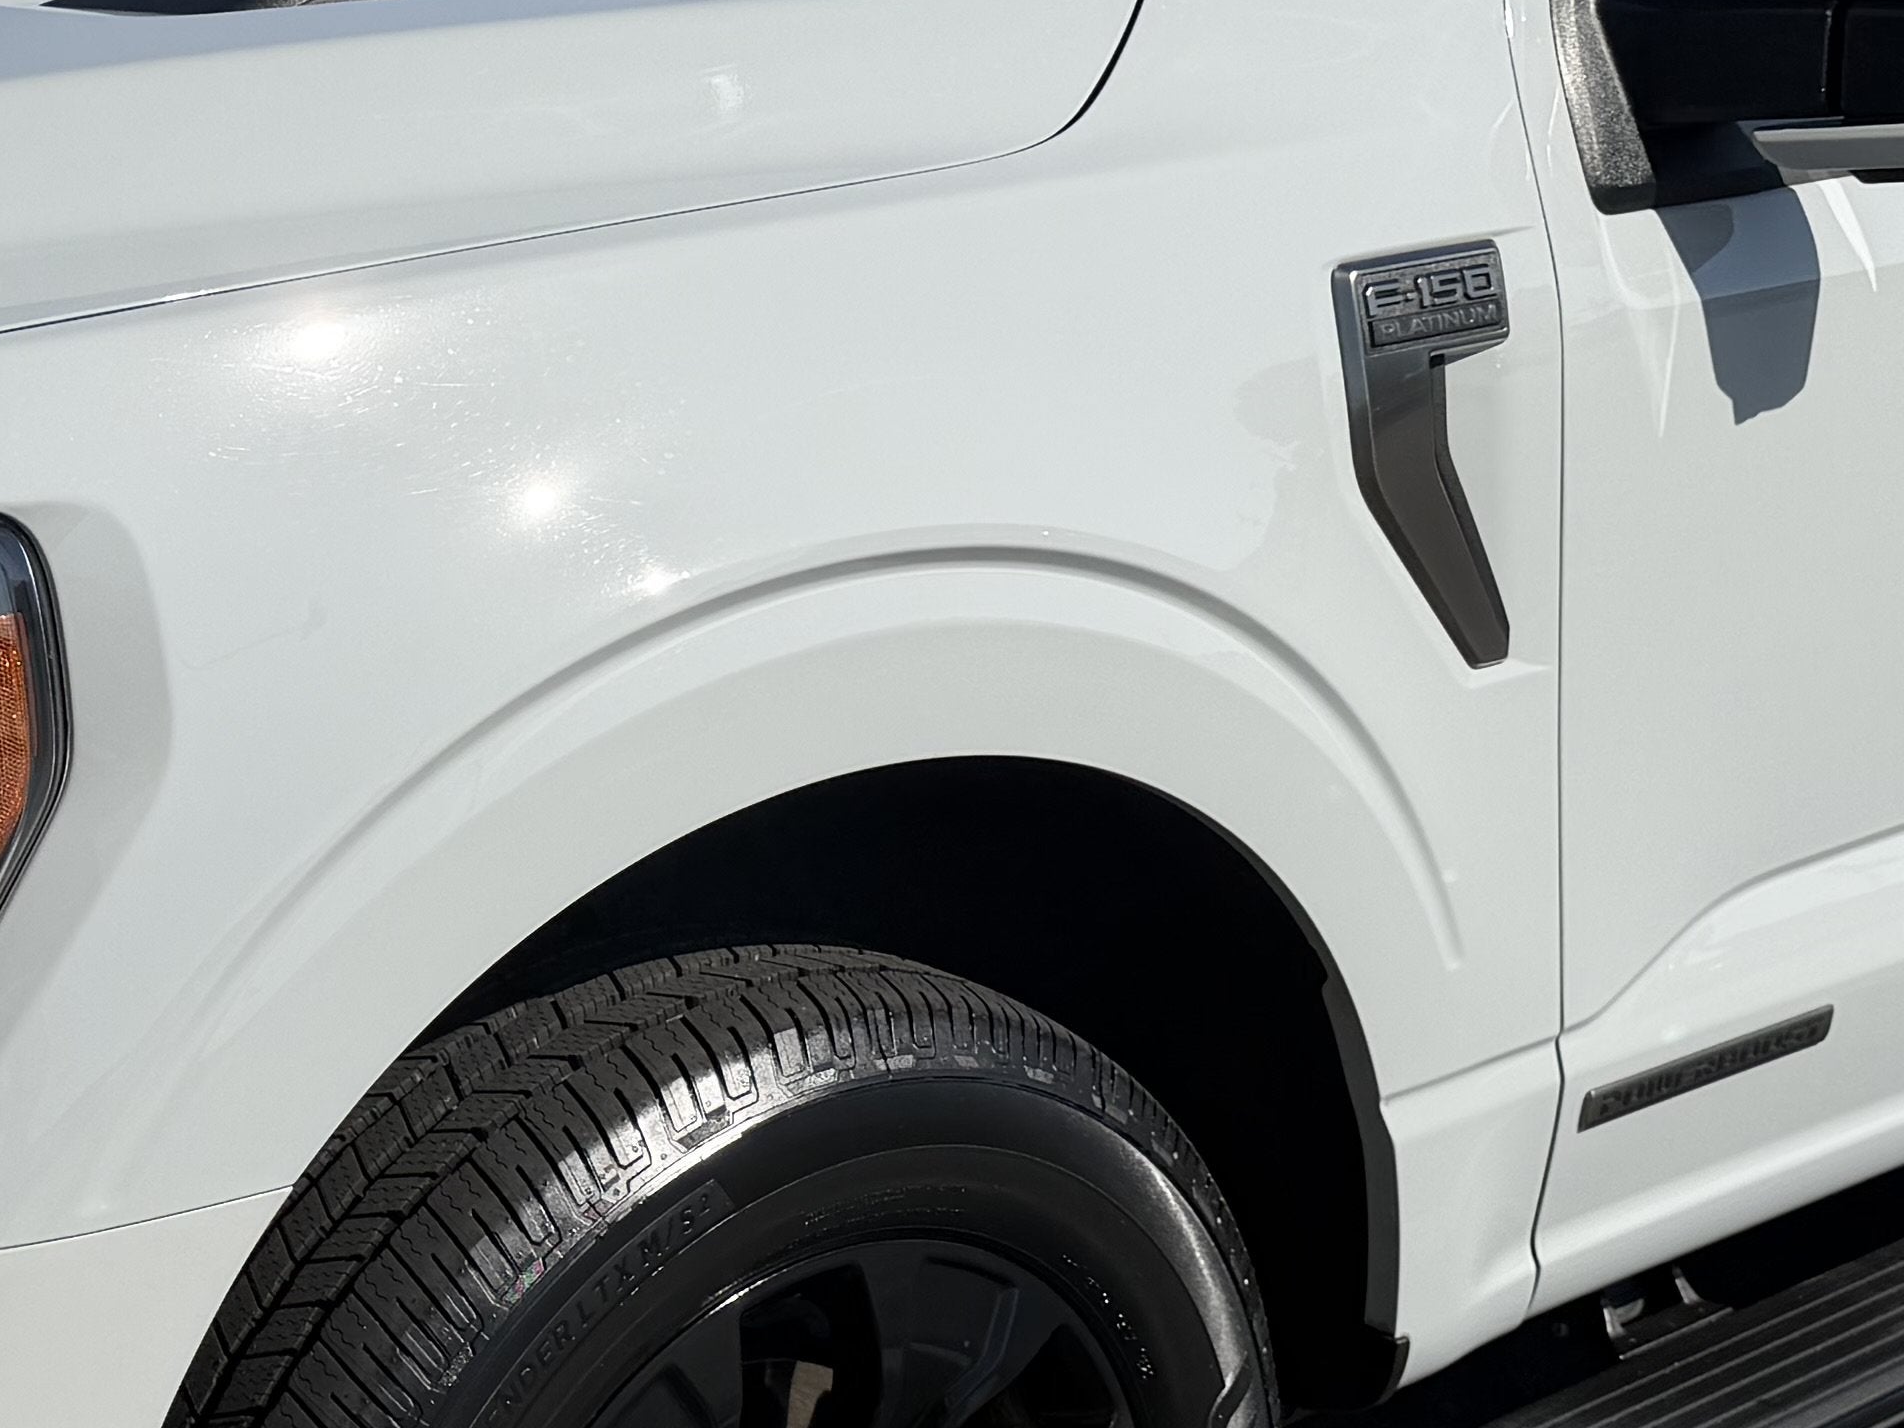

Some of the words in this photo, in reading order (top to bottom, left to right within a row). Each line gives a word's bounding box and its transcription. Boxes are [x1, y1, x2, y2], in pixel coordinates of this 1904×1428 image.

[1362, 263, 1498, 319] F-150
[1379, 303, 1497, 338] PLATINUM
[578, 1260, 636, 1330] LTX
